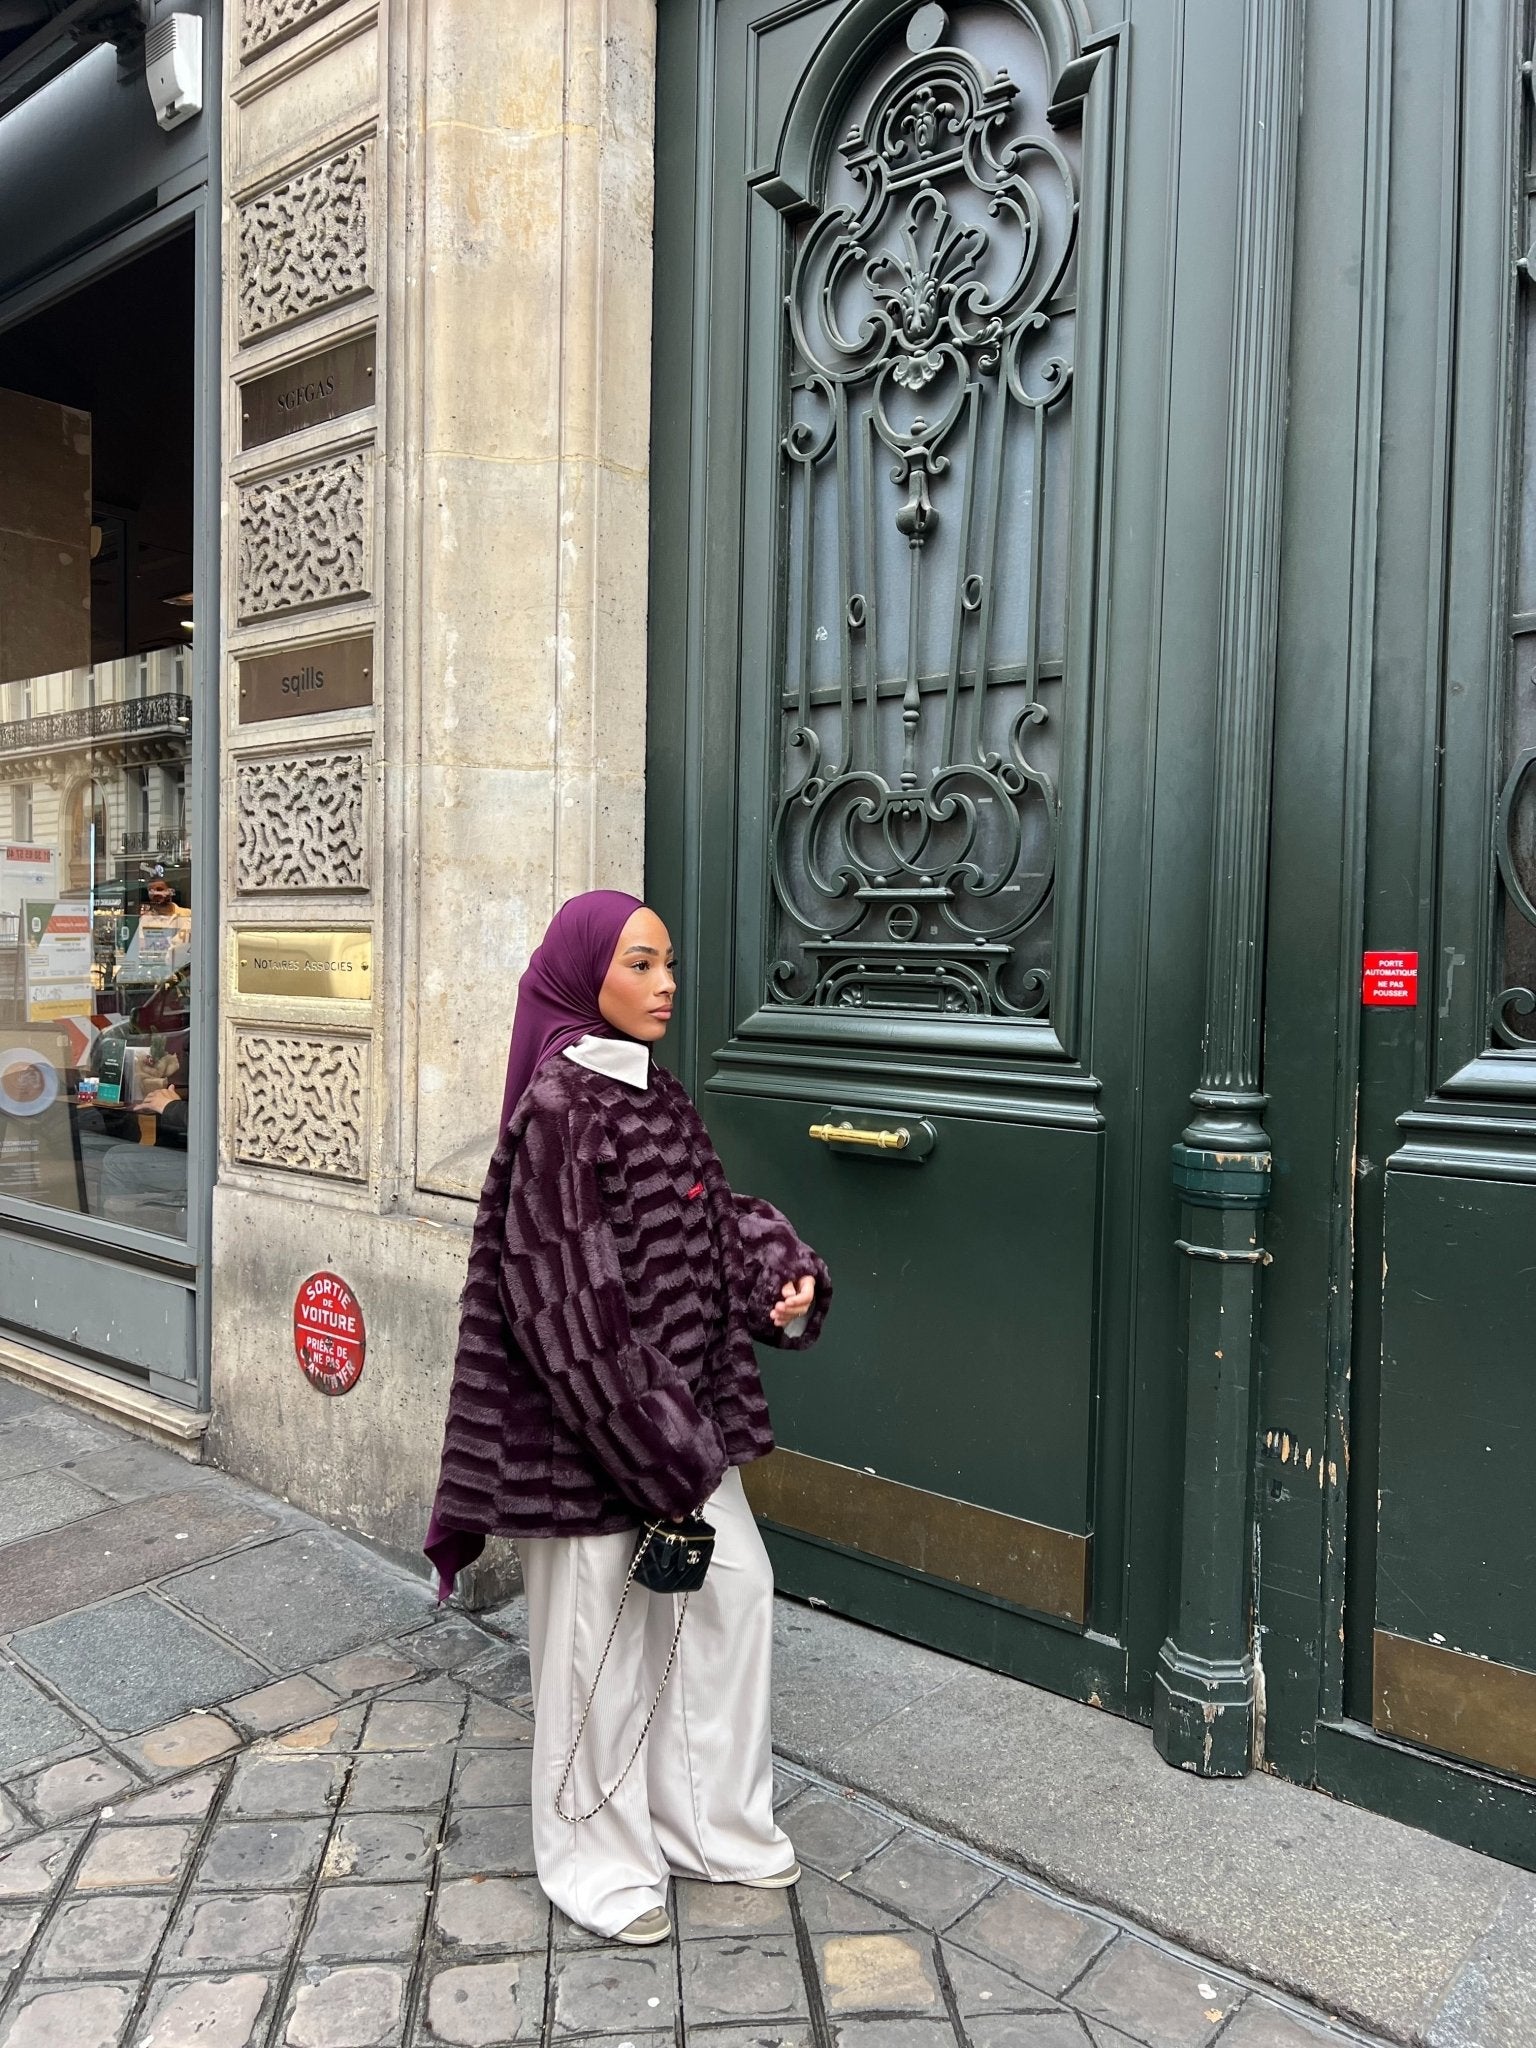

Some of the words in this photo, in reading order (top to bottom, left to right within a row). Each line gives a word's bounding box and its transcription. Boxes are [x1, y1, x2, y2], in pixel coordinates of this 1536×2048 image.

[281, 666, 324, 698] sqills
[1378, 959, 1404, 967] PORTE
[1377, 980, 1388, 988] NE
[1389, 980, 1404, 988] PAS
[1373, 989, 1409, 997] POUSSER
[306, 1279, 352, 1311] SORTIE
[322, 1298, 334, 1309] DE
[301, 1303, 356, 1333] VOITURE
[336, 1345, 348, 1360] DE
[313, 1351, 324, 1365] NE
[325, 1355, 341, 1370] PAS
